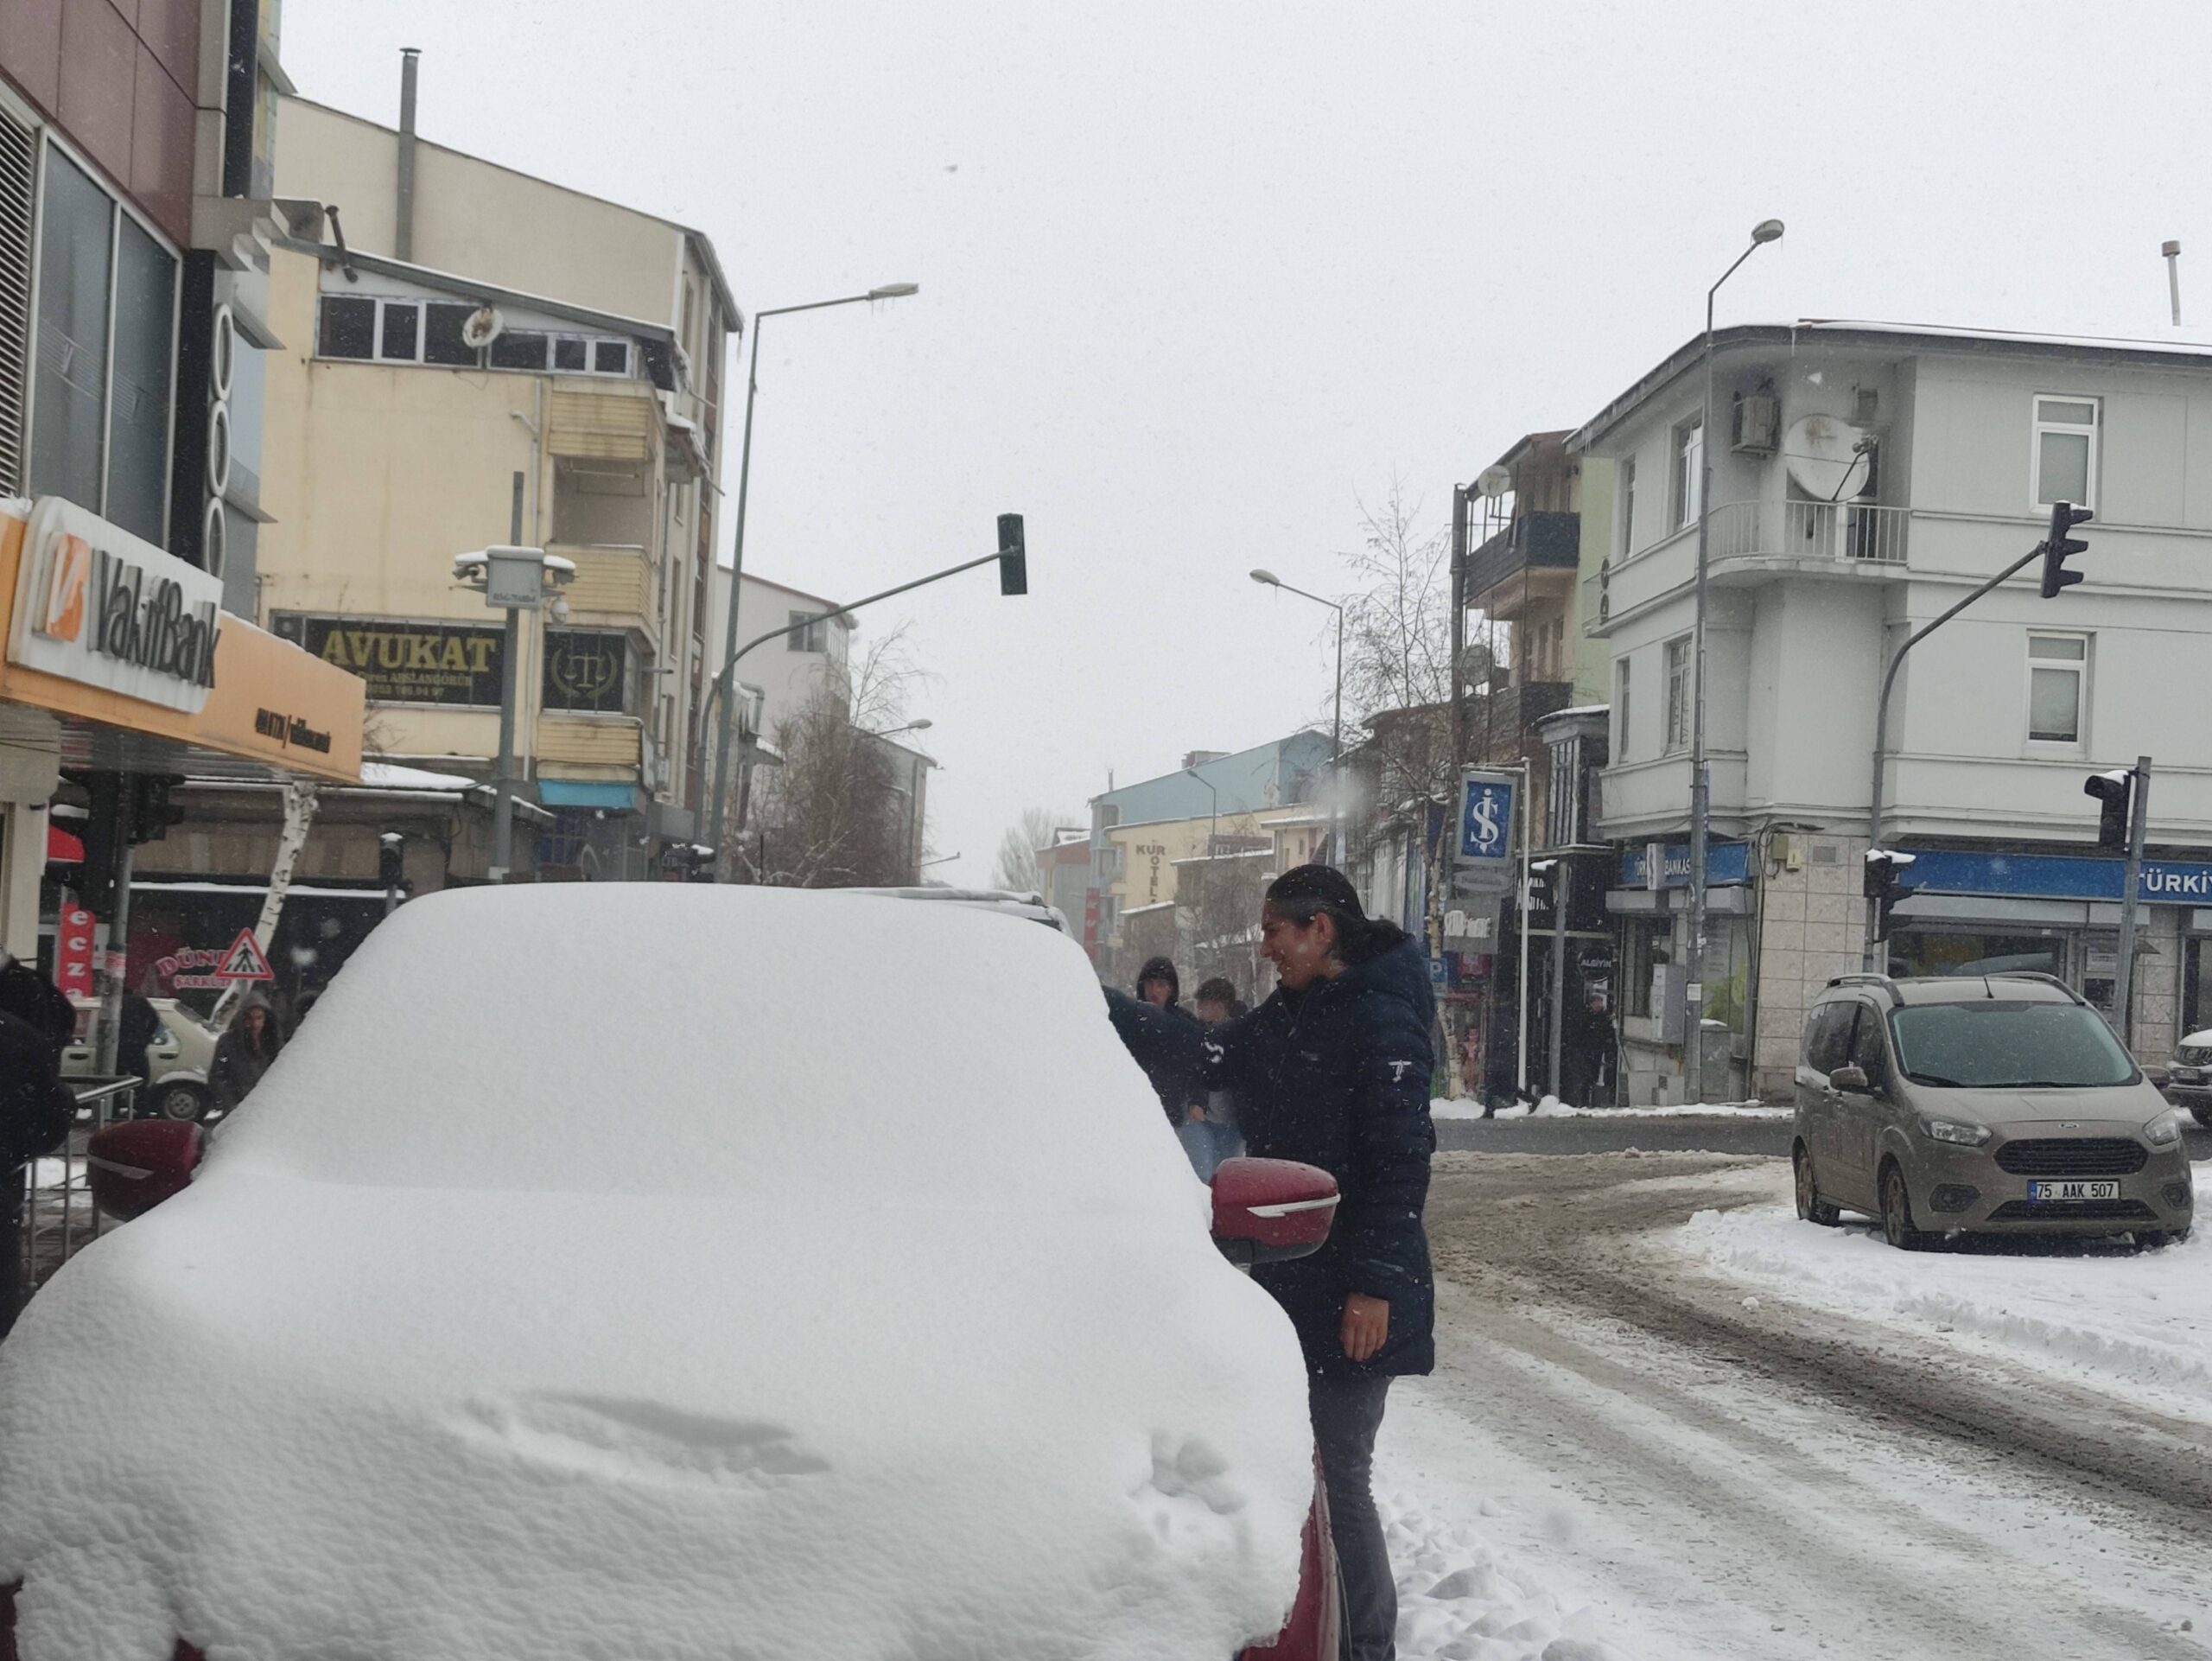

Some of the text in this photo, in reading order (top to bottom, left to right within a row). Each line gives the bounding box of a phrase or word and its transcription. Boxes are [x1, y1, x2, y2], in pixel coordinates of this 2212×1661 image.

[321, 630, 496, 671] AVUKAT
[1149, 856, 1160, 897] OTEL
[2139, 868, 2212, 894] ÜRKİ
[1430, 962, 1442, 983] P
[2037, 1184, 2113, 1198] 75 AAK 507
